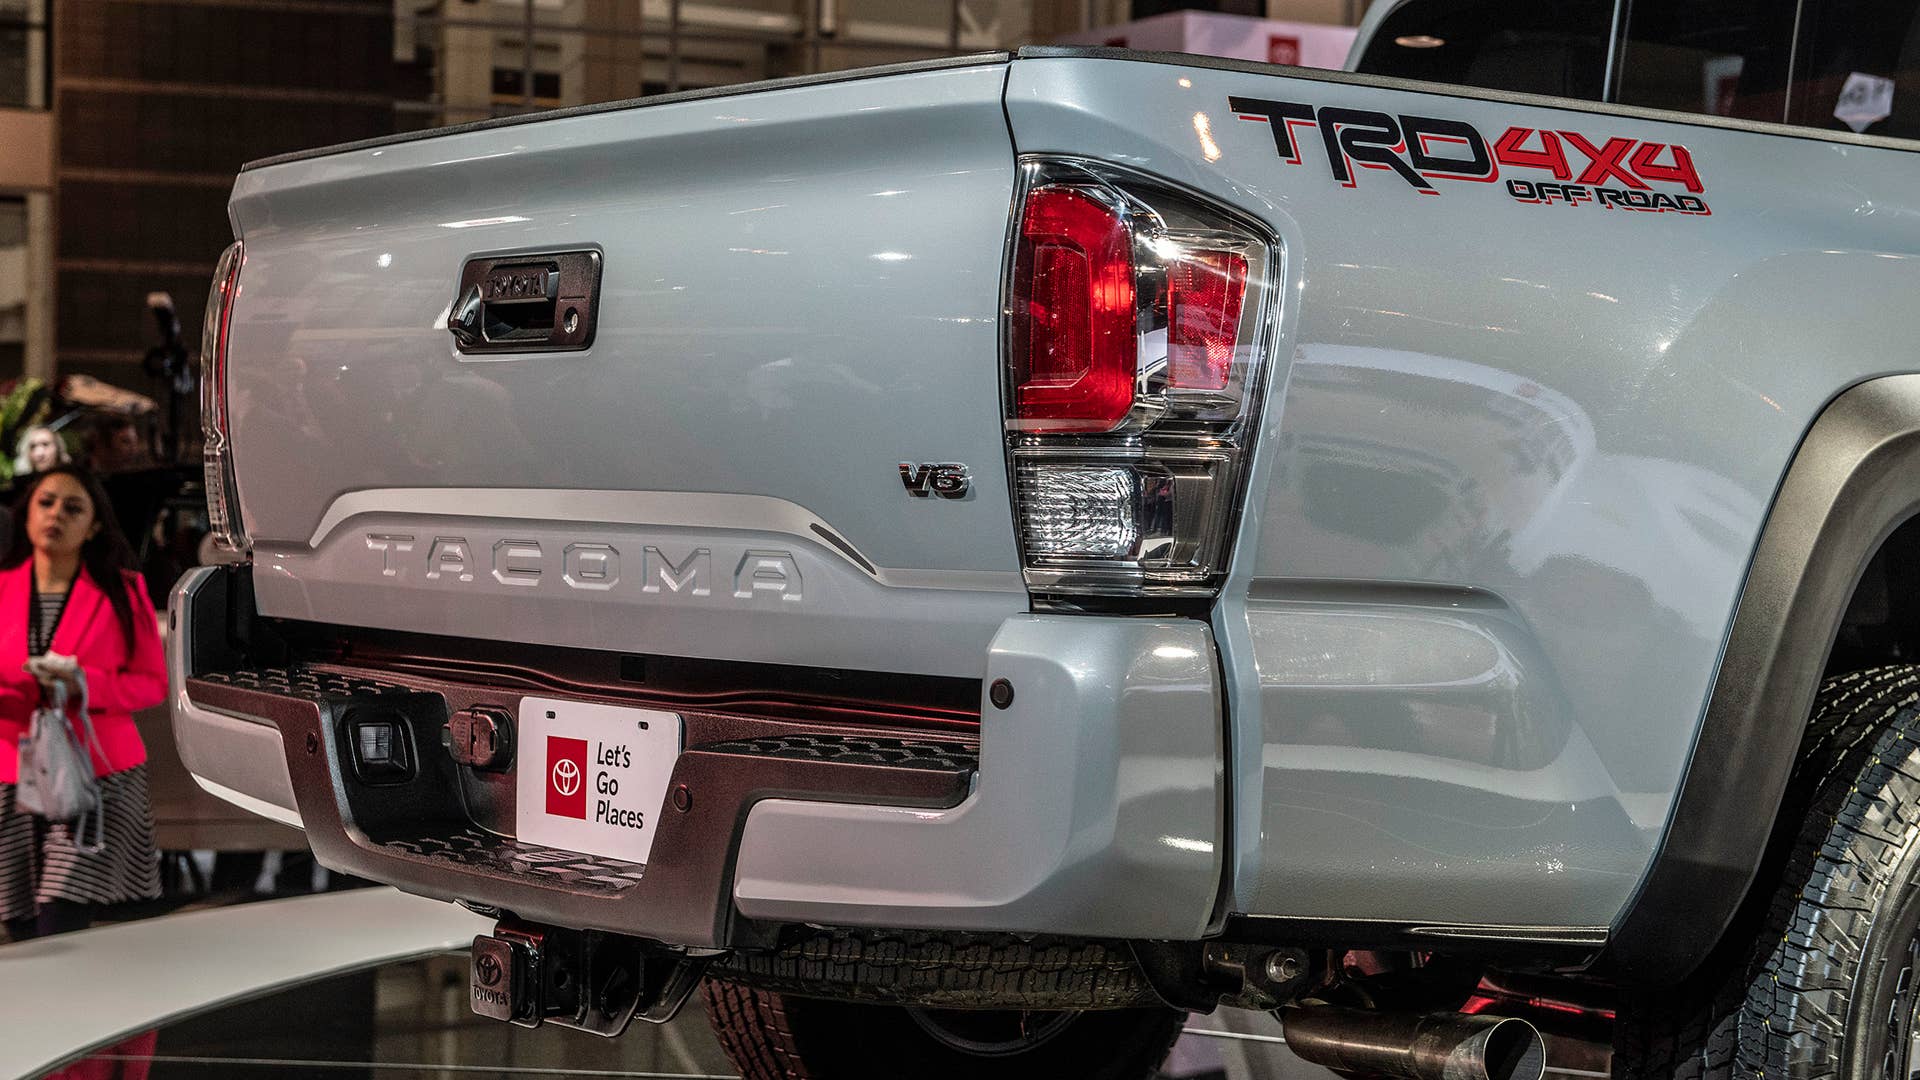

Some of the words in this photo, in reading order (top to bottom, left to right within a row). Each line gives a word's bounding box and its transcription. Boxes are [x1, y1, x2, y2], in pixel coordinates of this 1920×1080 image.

[1228, 96, 1500, 195] TRD
[1506, 178, 1597, 206] OFF
[1599, 186, 1711, 216] ROAD
[486, 271, 546, 298] TOYOTA
[898, 461, 972, 500] V6
[366, 532, 803, 601] TACOMA
[596, 741, 631, 769] Let's
[596, 771, 619, 796] Go
[596, 800, 644, 829] Places
[473, 984, 508, 1006] TOYOTA
